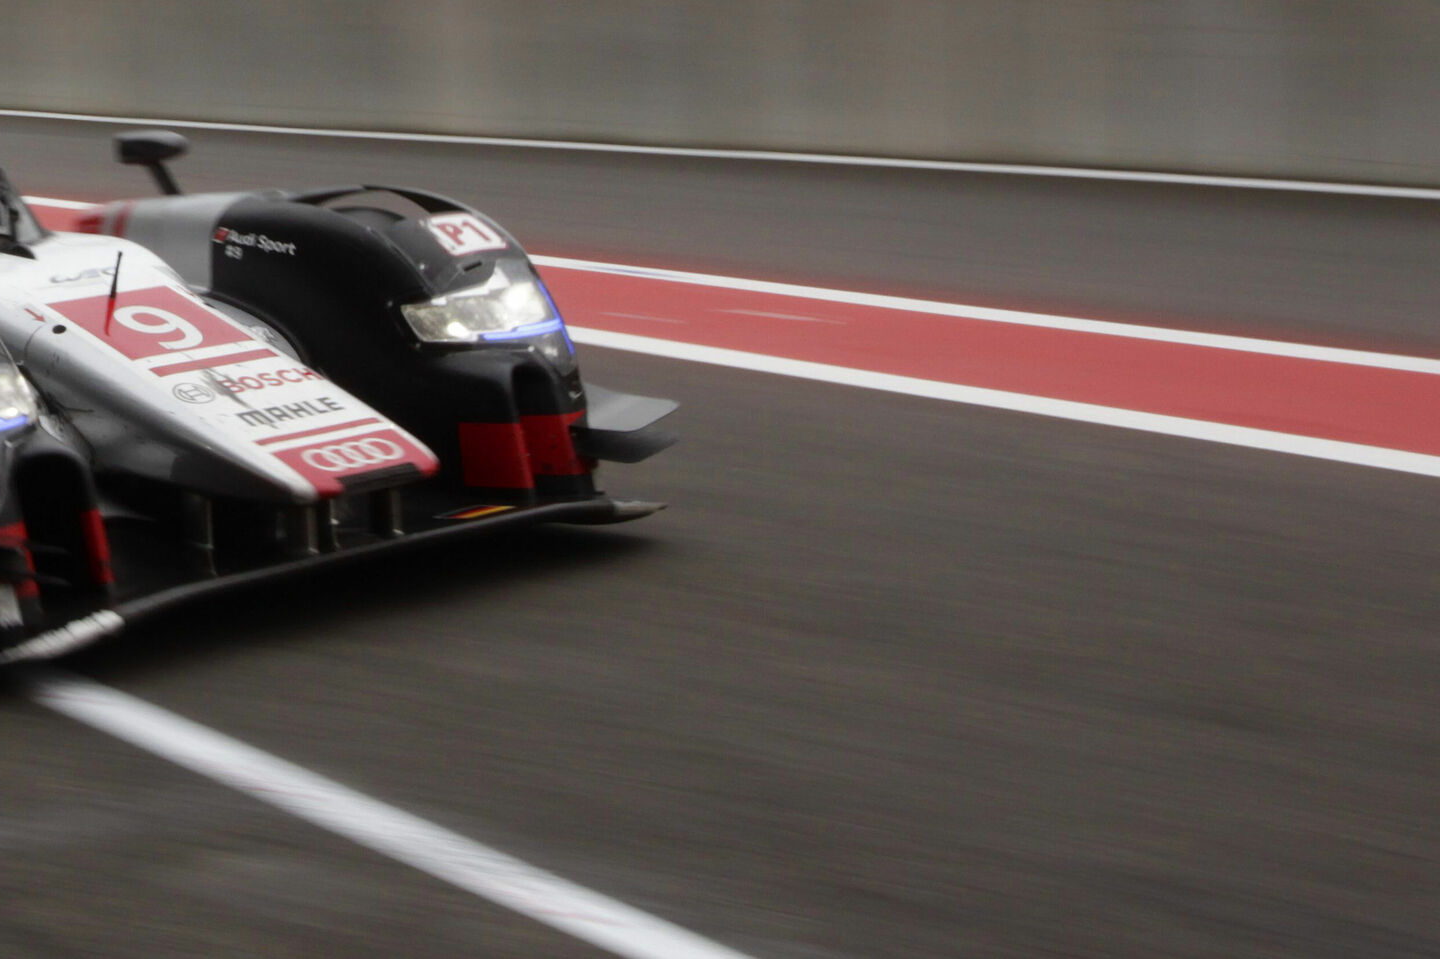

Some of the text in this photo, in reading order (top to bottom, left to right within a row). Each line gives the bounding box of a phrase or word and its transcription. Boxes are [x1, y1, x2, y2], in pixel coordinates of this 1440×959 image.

[227, 229, 296, 255] Audi Sport
[436, 221, 492, 246] P1
[112, 305, 204, 350] 9
[219, 367, 326, 394] BOSCH
[236, 396, 345, 428] MAHLE
